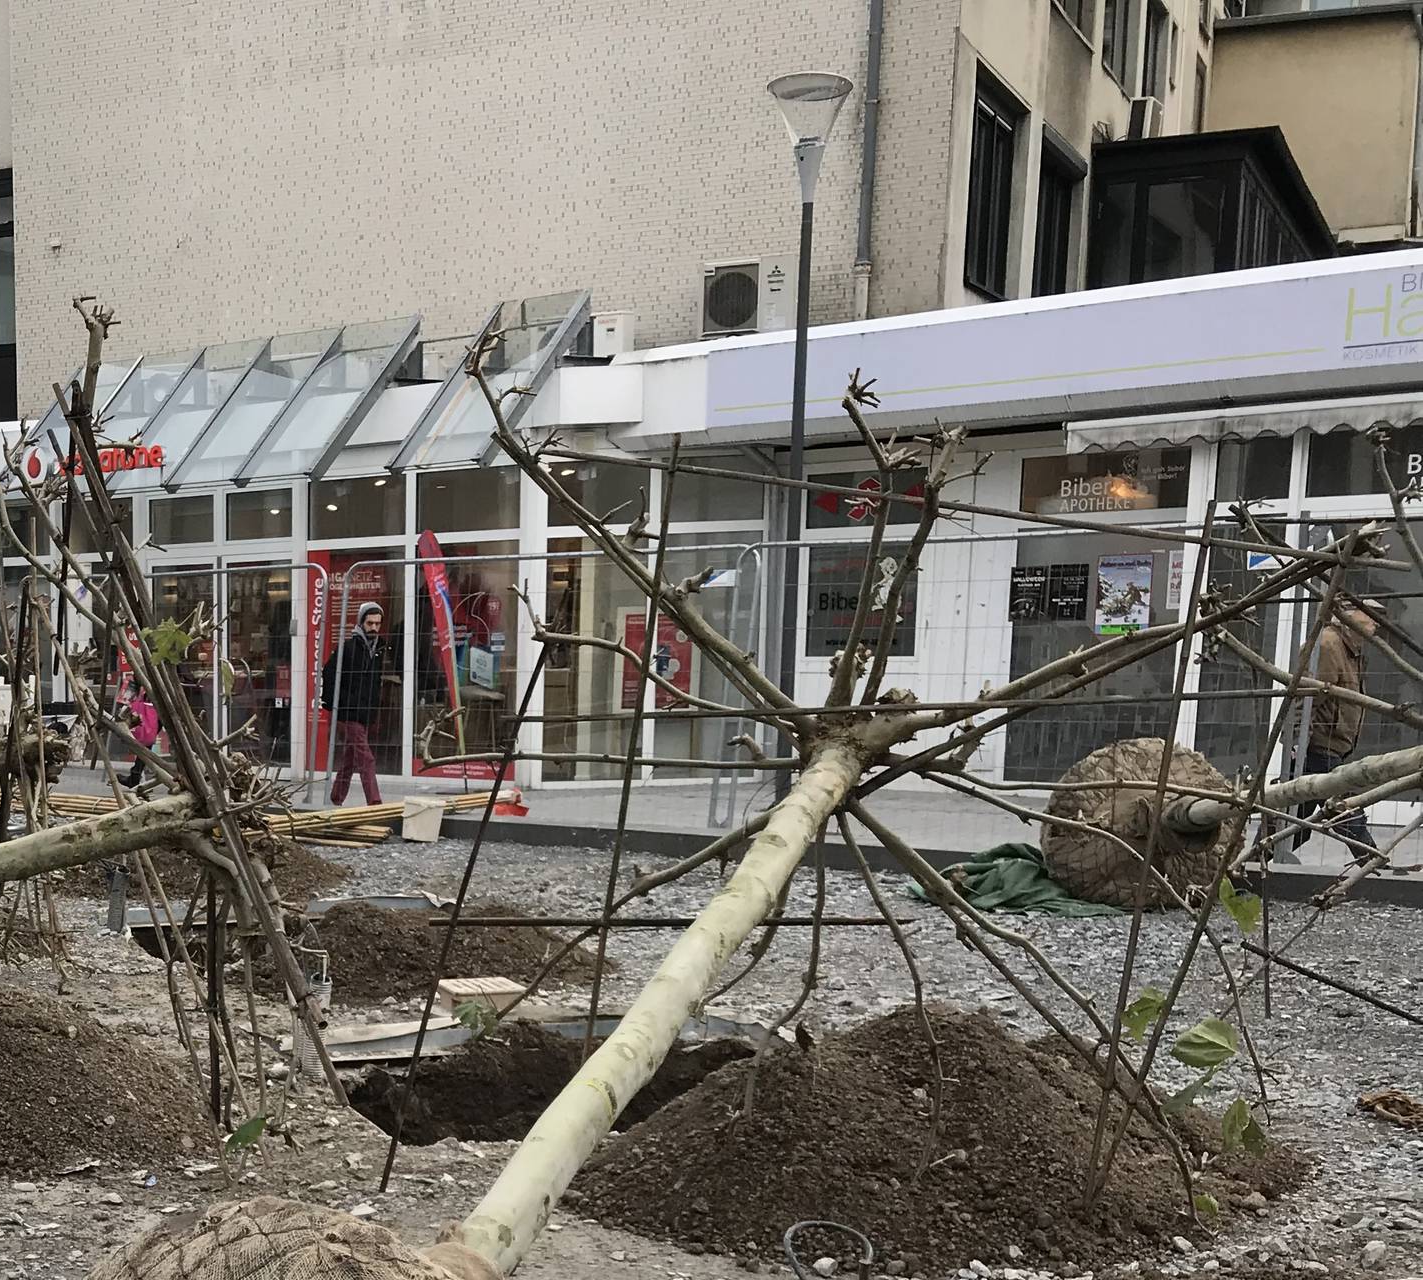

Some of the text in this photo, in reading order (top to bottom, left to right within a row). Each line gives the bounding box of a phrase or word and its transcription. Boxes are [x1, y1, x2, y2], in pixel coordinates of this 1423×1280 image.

[1343, 343, 1418, 361] KOSMETIK
[1060, 478, 1111, 498] Biber
[1059, 497, 1130, 513] APOTHEKE
[311, 578, 324, 626] Store
[819, 592, 858, 611] Bibe
